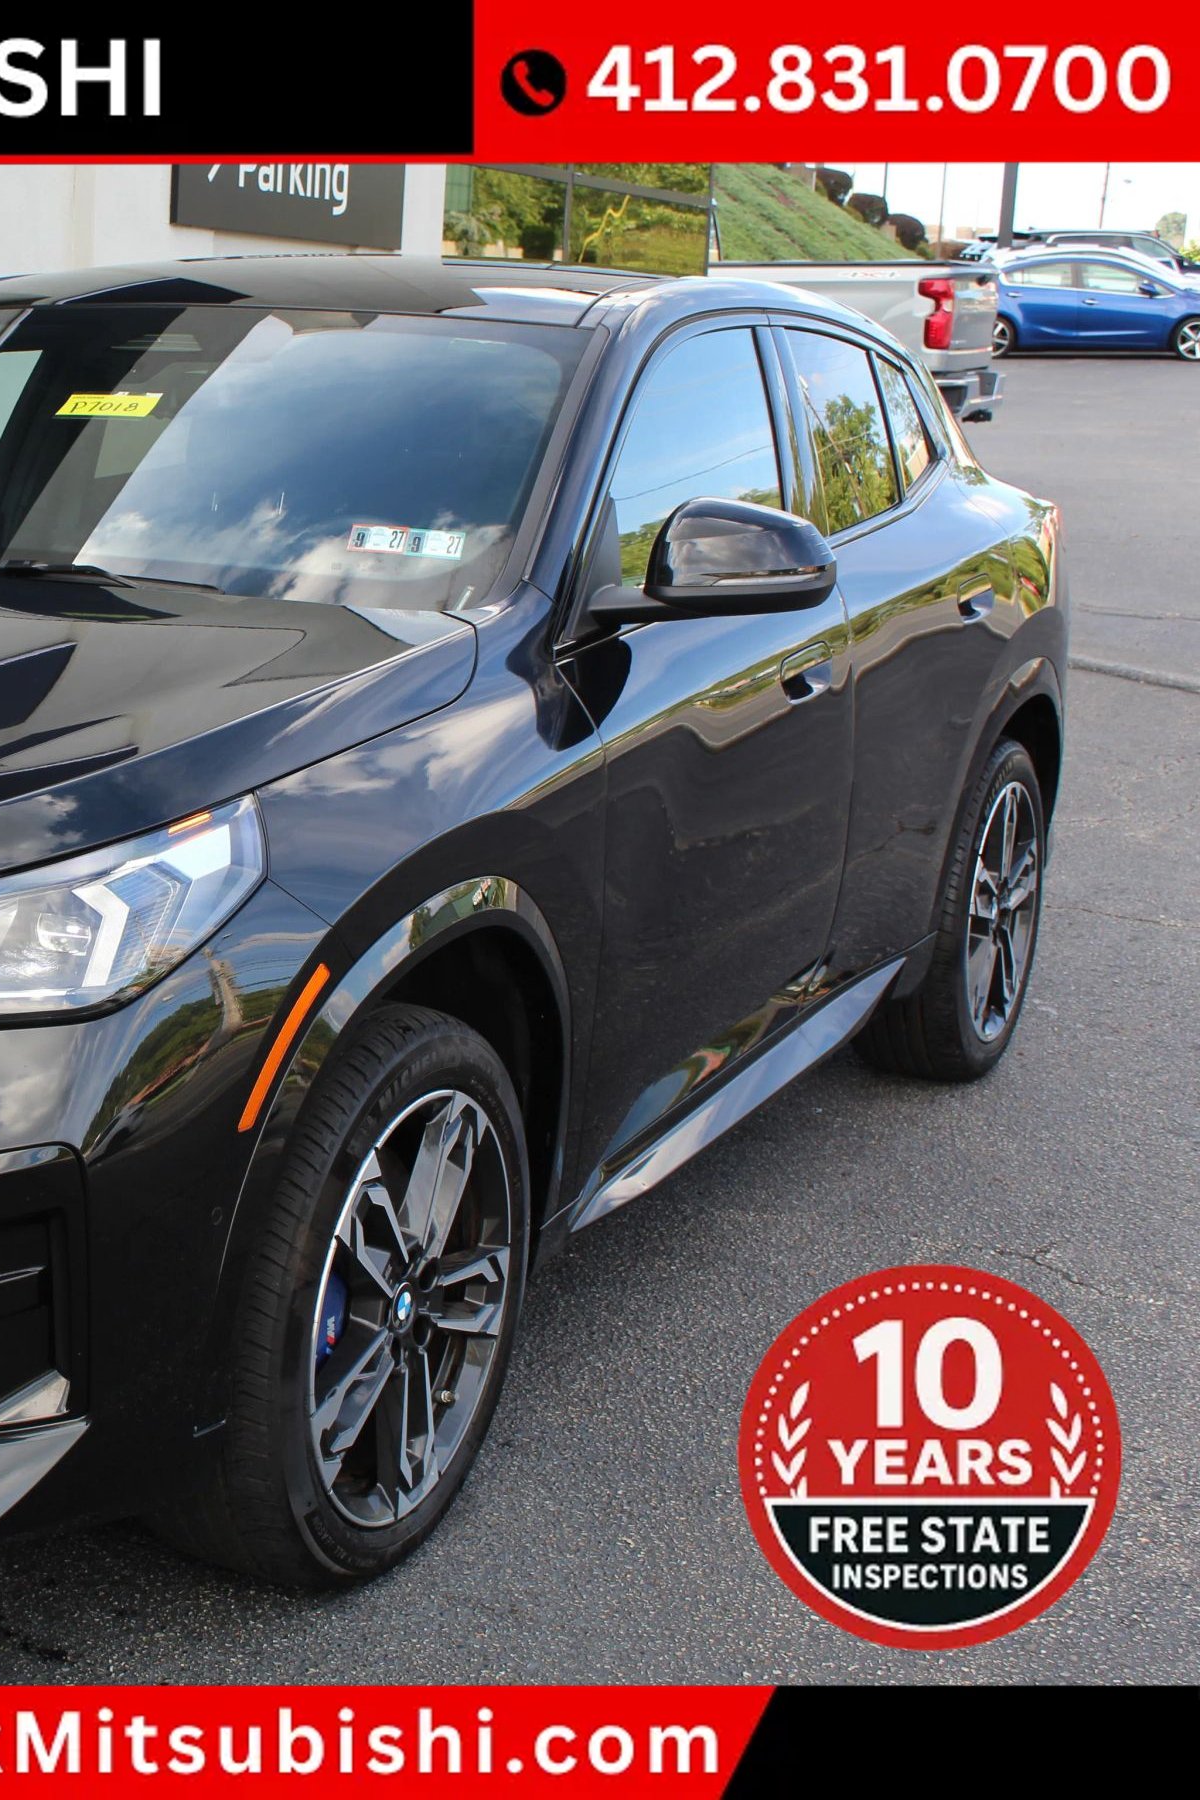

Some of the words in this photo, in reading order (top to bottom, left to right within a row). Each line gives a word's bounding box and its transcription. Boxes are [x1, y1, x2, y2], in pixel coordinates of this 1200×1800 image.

[238, 164, 350, 216] Parking
[70, 401, 140, 414] P7018
[354, 531, 366, 548] 9
[389, 530, 405, 549] 27
[410, 536, 422, 553] 9
[446, 535, 462, 555] 27
